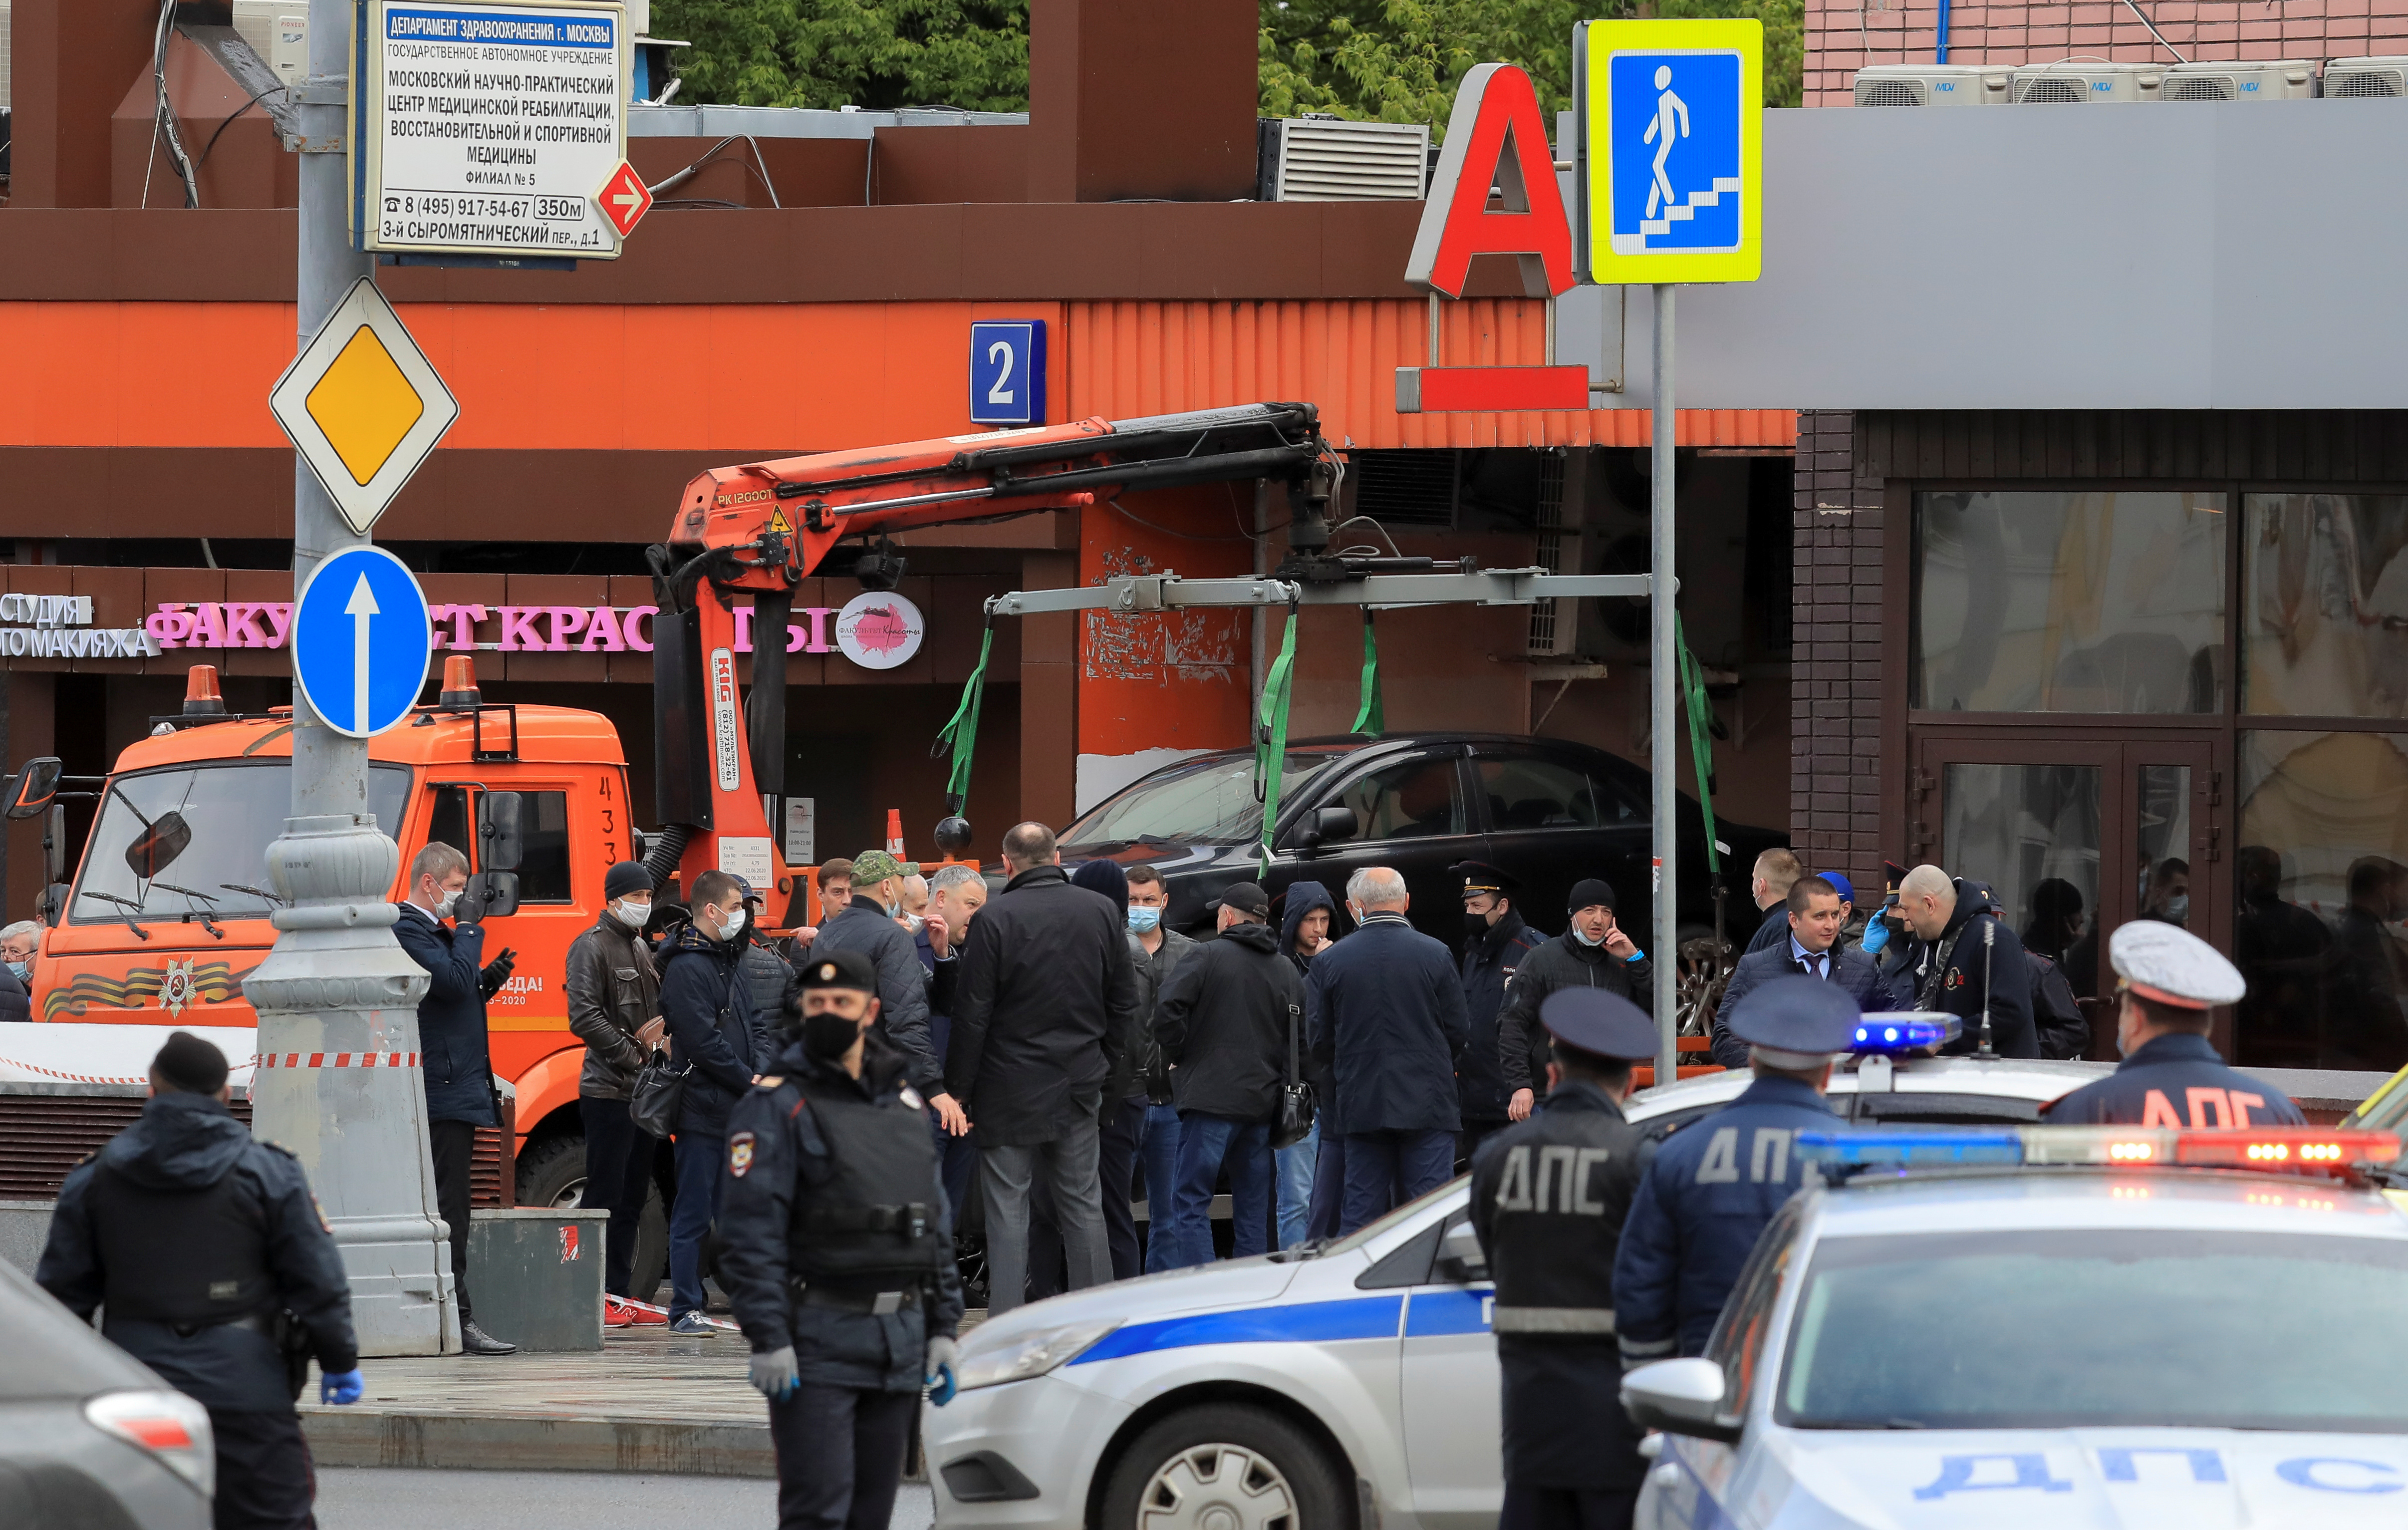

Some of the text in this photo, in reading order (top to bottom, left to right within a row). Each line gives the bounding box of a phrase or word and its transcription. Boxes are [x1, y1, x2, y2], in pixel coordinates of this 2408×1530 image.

[390, 16, 610, 43] ДЕПАРТАМЕНТ ЗДРАВООХРАНЕНИЯ г. МОСКВЫ
[388, 44, 613, 66] ГОСУДАРСТВЕННОЕ АВТОНОМНОЕ УЧРЕЖДЕНИЕ
[389, 68, 613, 94] МОСКОВСКИЙ НАУЧНО-ПРАКТИЧЕСКИЙ
[1934, 83, 1955, 91] MDV
[2091, 82, 2112, 91] MDV
[2239, 81, 2260, 92] MDV
[388, 95, 614, 123] ЦЕНТР МЕДИЦИНСКОЙ РЕАБИЛИТАЦИИ,
[391, 120, 611, 144] ВОССТАНОВИТЕЛЬНОЙ И СПОРТИВНОЙ
[467, 146, 536, 167] МЕДИЦИНЫ
[466, 171, 535, 186] ФИЛИАЛ № 5
[405, 196, 413, 213] 8
[417, 197, 454, 219] (495)
[458, 199, 529, 218] 917-54-67
[408, 221, 549, 243] СЫРОМЯТНИЧЕСКИЙ
[989, 341, 1014, 404] 2
[718, 494, 733, 505] PK
[0, 593, 80, 629] СТУДИЯ
[497, 606, 831, 652] КРАСТЫ
[883, 624, 921, 635] Красоты
[0, 628, 155, 658] ГО МАКИЯЖА
[718, 657, 731, 702] KIG
[499, 976, 543, 994] ЕДА!
[1495, 1145, 1609, 1216] ДПС
[1912, 1447, 2406, 1501] ДПС
